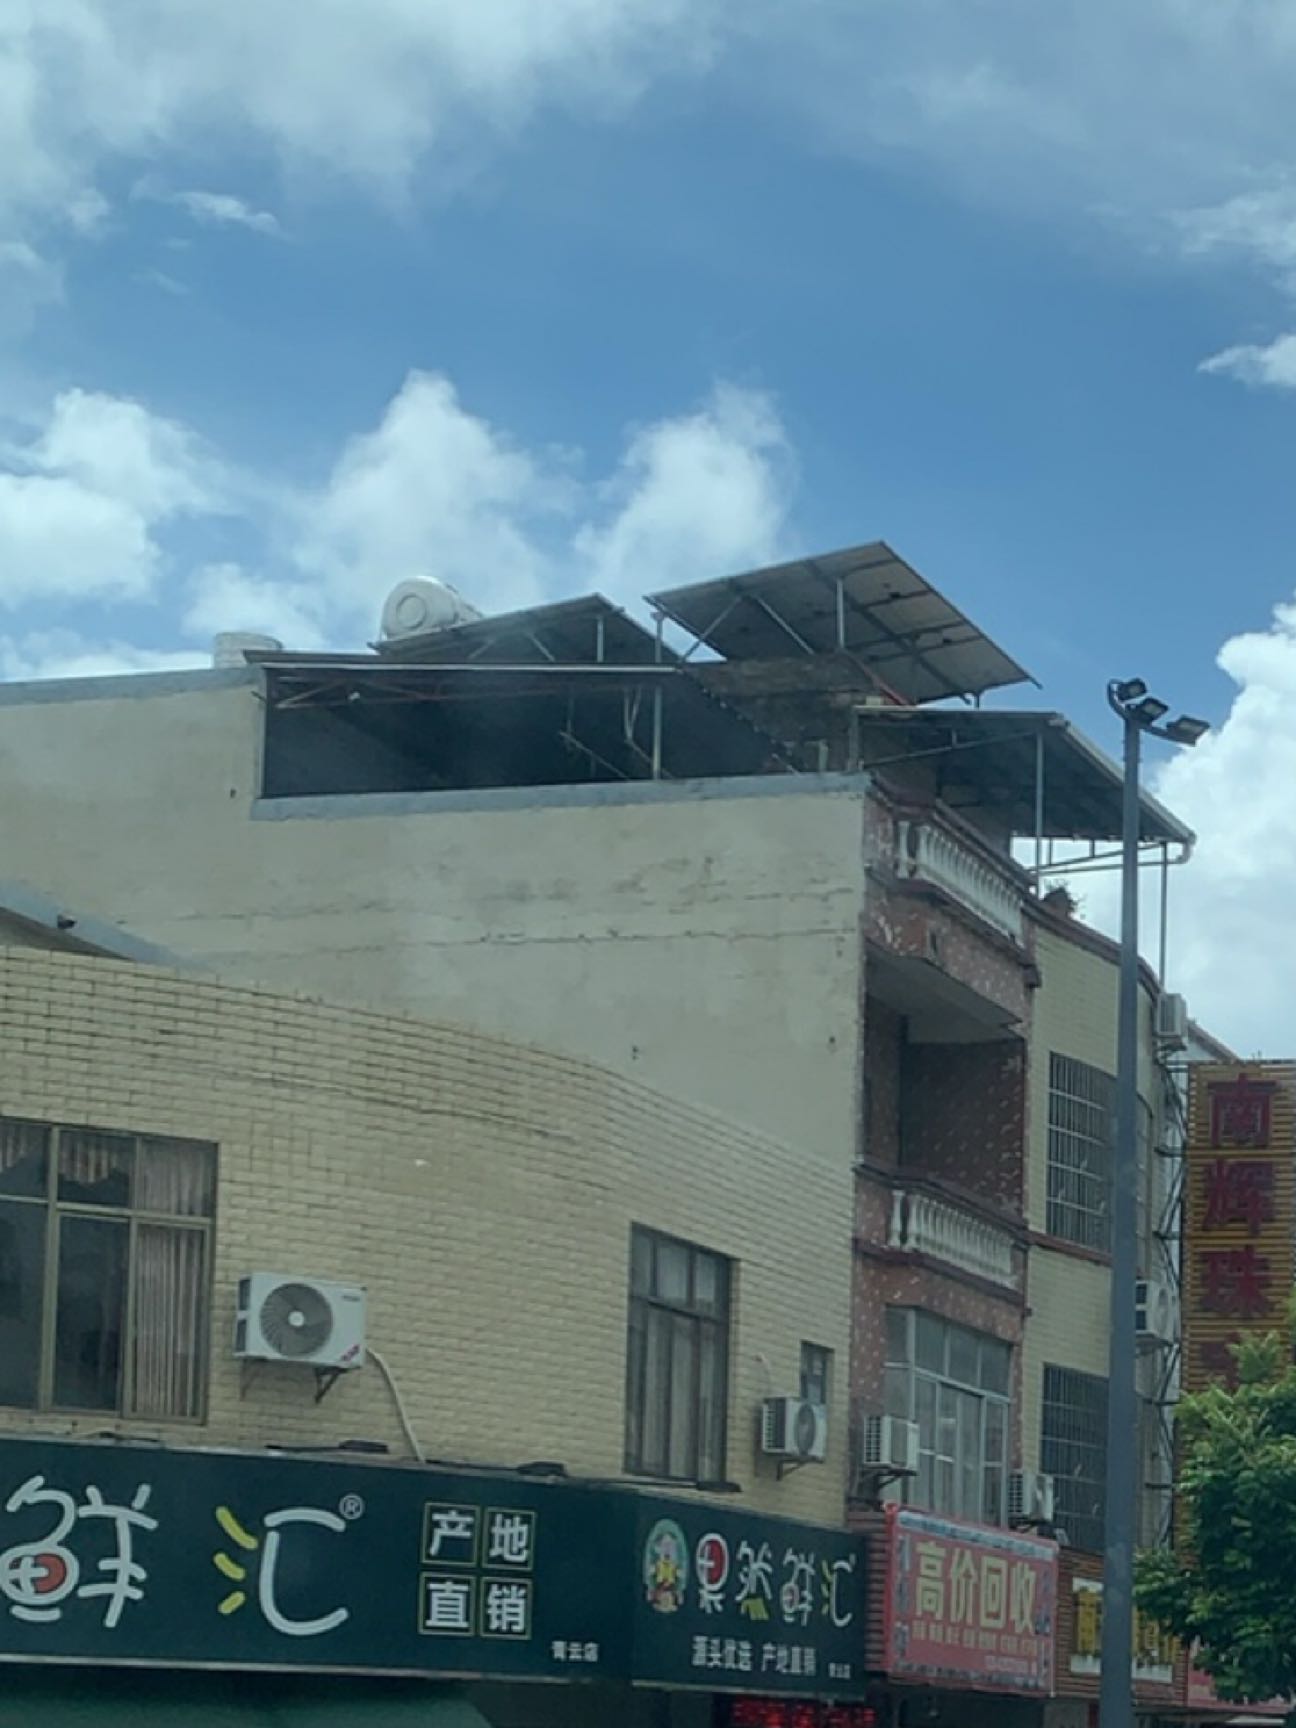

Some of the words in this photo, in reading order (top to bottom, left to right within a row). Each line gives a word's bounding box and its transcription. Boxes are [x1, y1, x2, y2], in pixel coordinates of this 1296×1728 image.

[428, 1509, 530, 1563] 产地
[424, 1580, 527, 1633] 直销
[695, 1532, 854, 1628] 果然鲜汇
[914, 1541, 1037, 1636] 高价回收
